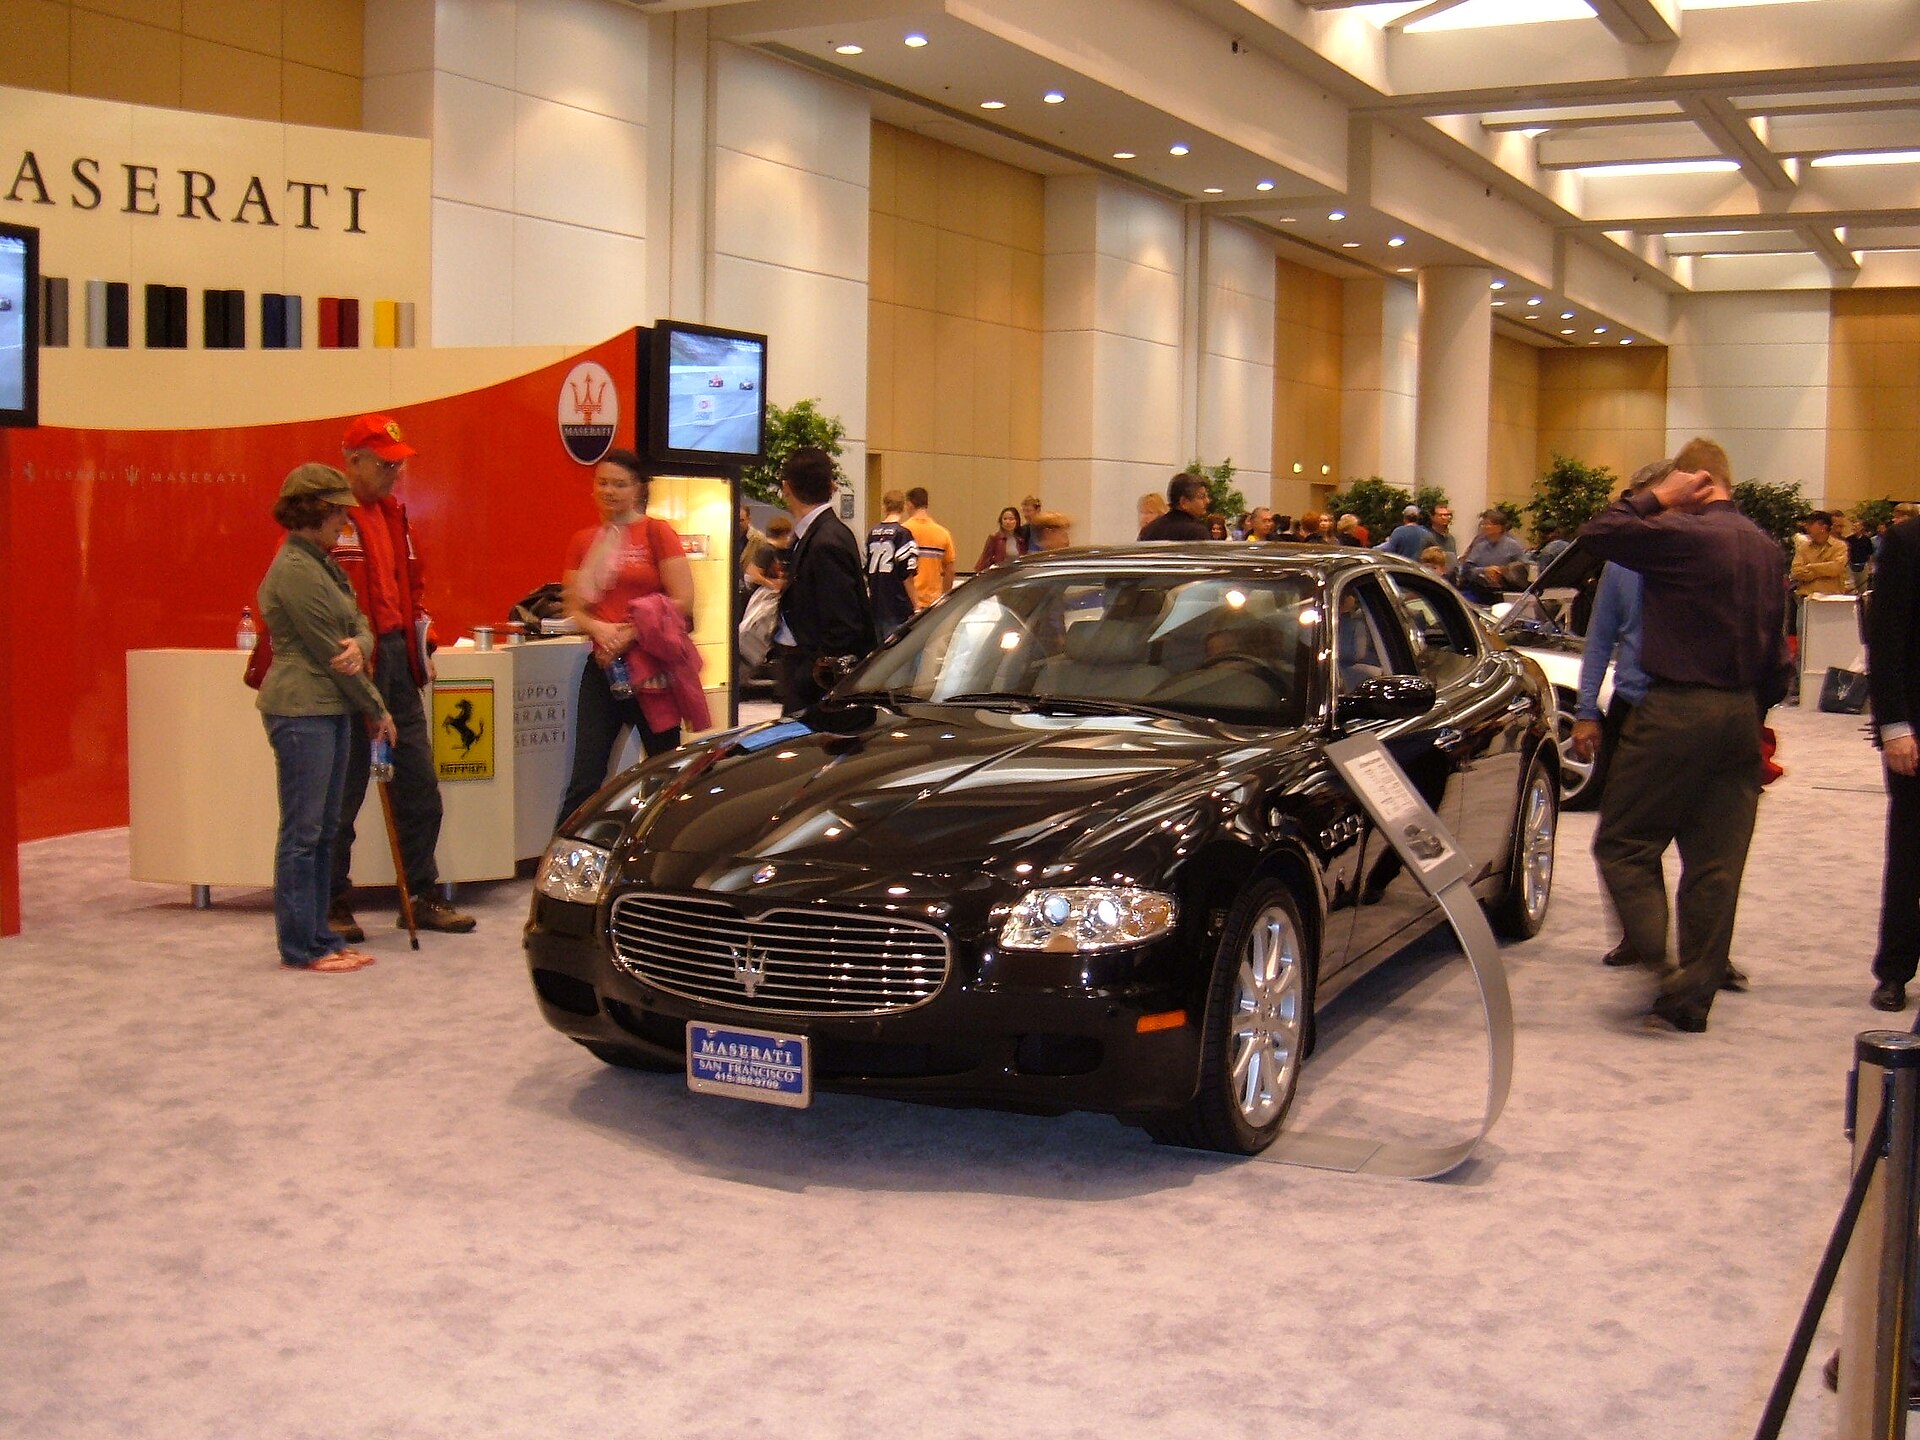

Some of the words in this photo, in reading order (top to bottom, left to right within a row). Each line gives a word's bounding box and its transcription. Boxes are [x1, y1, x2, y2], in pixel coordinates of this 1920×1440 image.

[3, 150, 367, 235] ASERATI
[151, 470, 248, 484] MASERATI
[868, 541, 896, 575] 72
[701, 1039, 793, 1065] MASERATI
[699, 1059, 722, 1072] SAN
[728, 1062, 795, 1084] FRANCISCO
